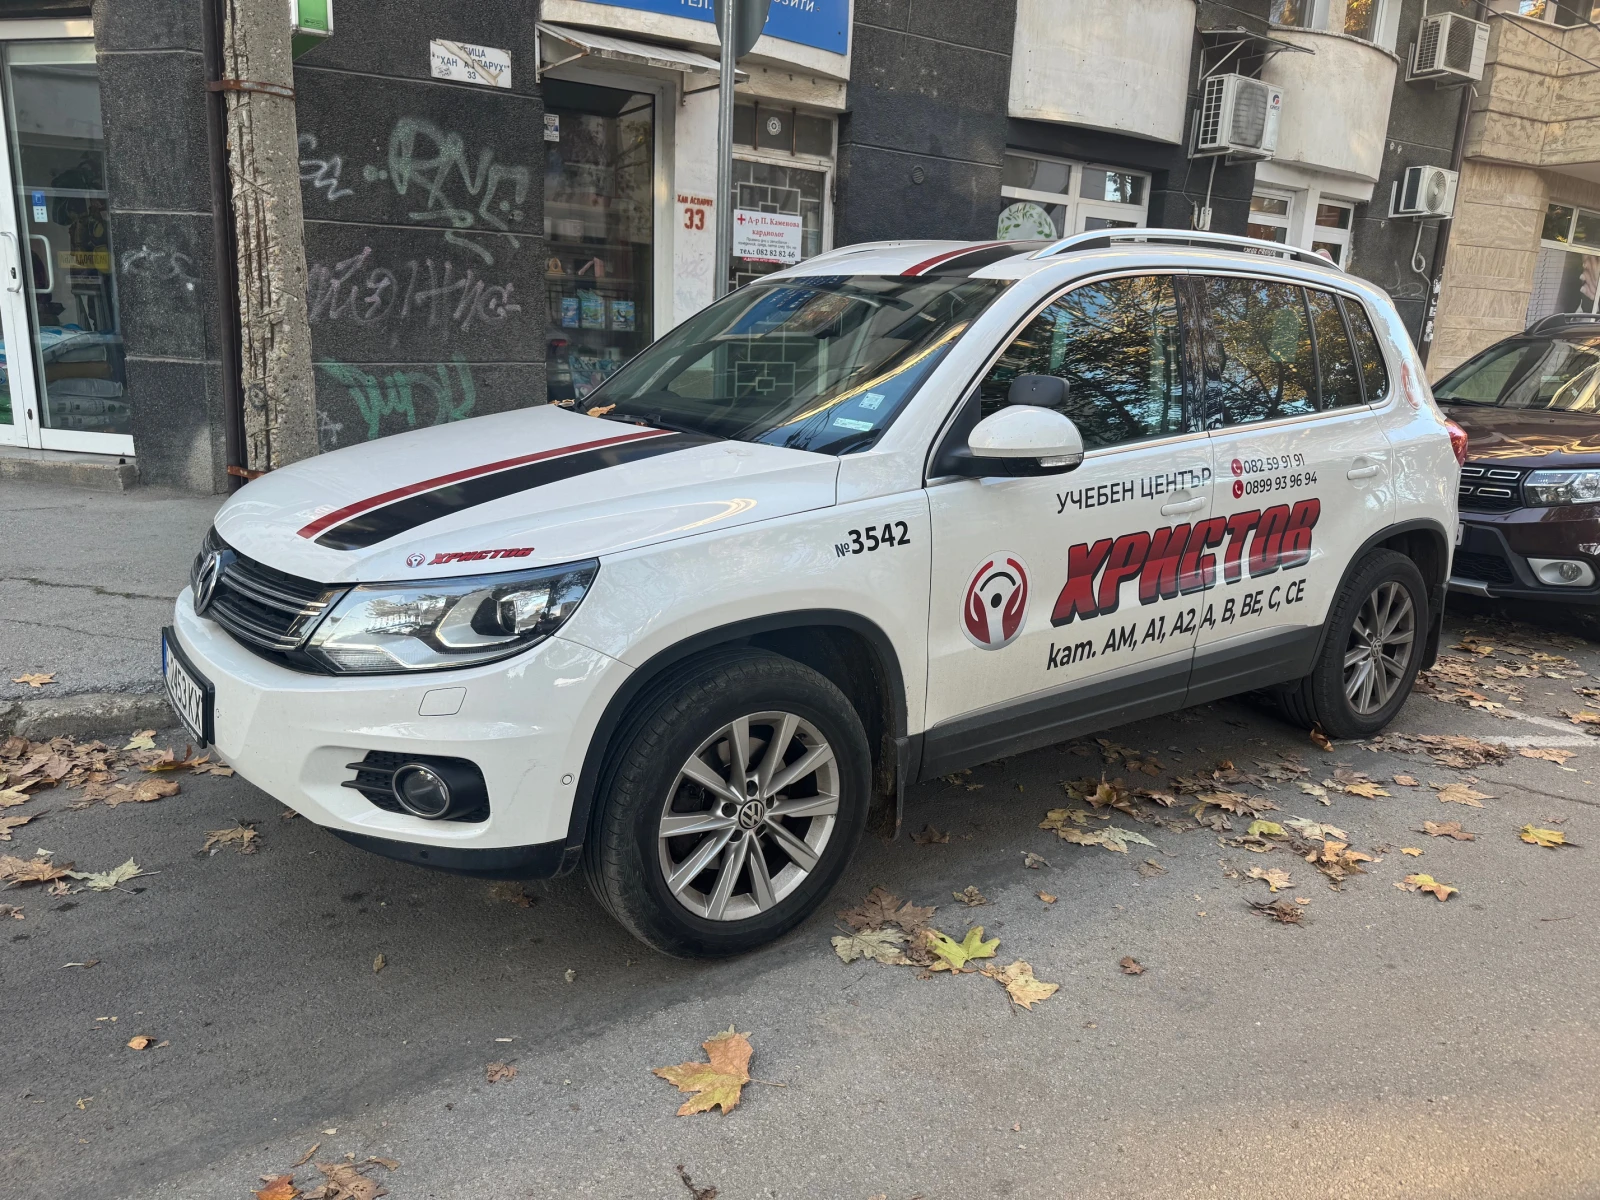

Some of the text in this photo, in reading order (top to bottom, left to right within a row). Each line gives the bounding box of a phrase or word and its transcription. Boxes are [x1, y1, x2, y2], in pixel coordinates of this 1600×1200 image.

[467, 71, 476, 80] 33
[684, 208, 705, 230] 33
[748, 216, 800, 228] Д-р П. Каменова
[752, 229, 785, 240] кардиолог
[770, 249, 777, 257] 82
[779, 250, 787, 258] 82
[1243, 453, 1305, 474] 082 59 91 91
[1056, 467, 1212, 515] УЧЕБЕН ЦЕНТЪР
[1245, 471, 1318, 496] 0899 93 96 94
[427, 547, 535, 566] ХРИСТОВ
[1051, 498, 1321, 627] ХРИСТОВ
